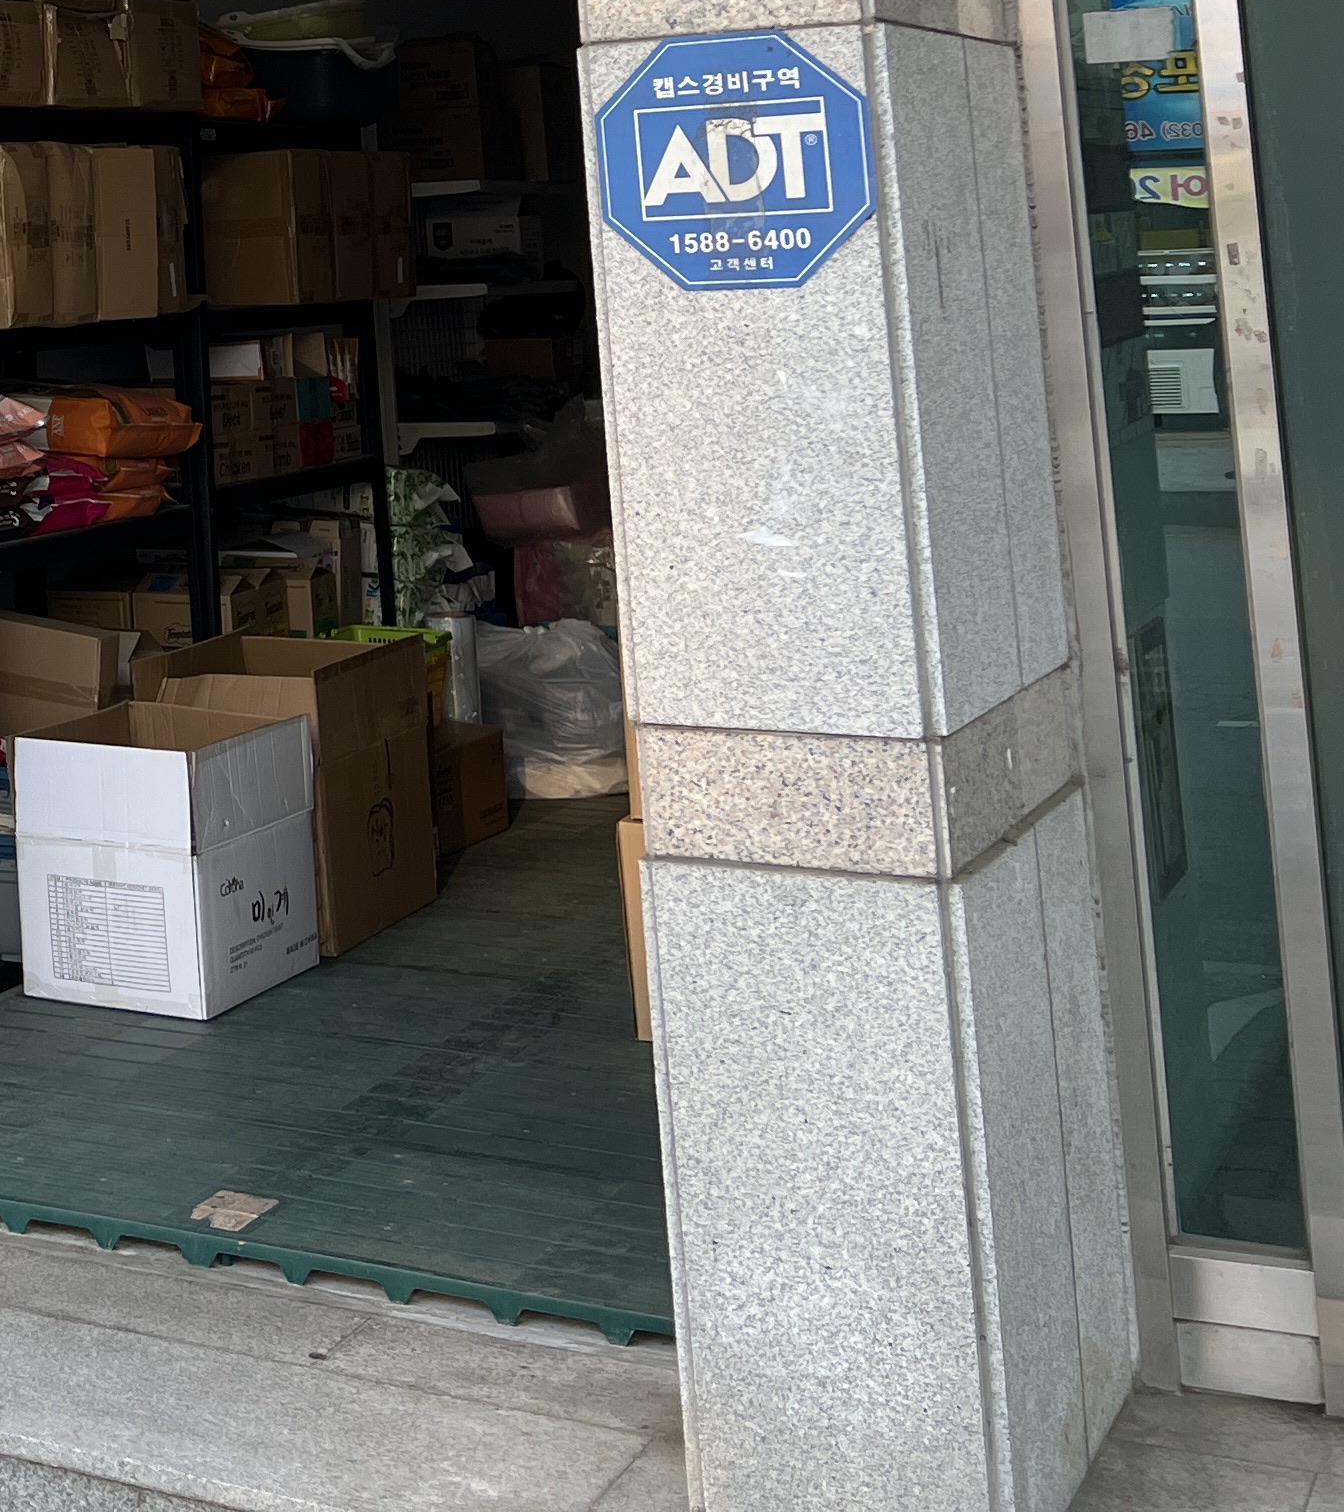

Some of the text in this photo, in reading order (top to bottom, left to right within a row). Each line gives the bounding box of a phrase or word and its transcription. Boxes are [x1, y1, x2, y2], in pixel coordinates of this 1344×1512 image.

[652, 66, 801, 99] 캡스경비구역
[644, 111, 826, 207] ADT
[668, 226, 812, 255] 1588-6400
[709, 256, 775, 272] 고객센터
